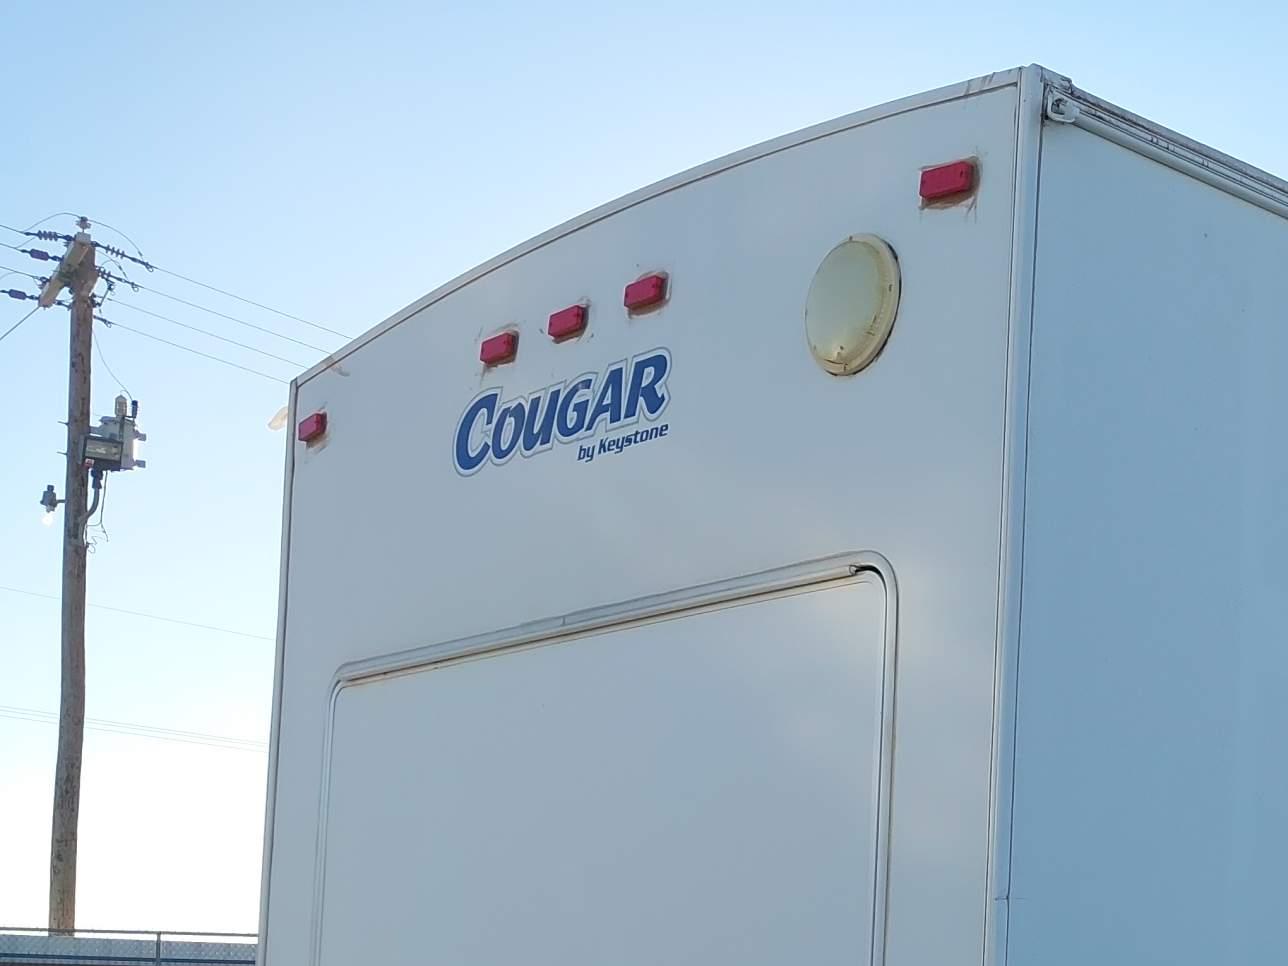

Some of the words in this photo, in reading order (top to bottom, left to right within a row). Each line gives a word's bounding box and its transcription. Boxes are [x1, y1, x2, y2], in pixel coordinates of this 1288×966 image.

[455, 351, 669, 472] COUGAR
[577, 444, 596, 463] by
[598, 423, 669, 455] Keystone
